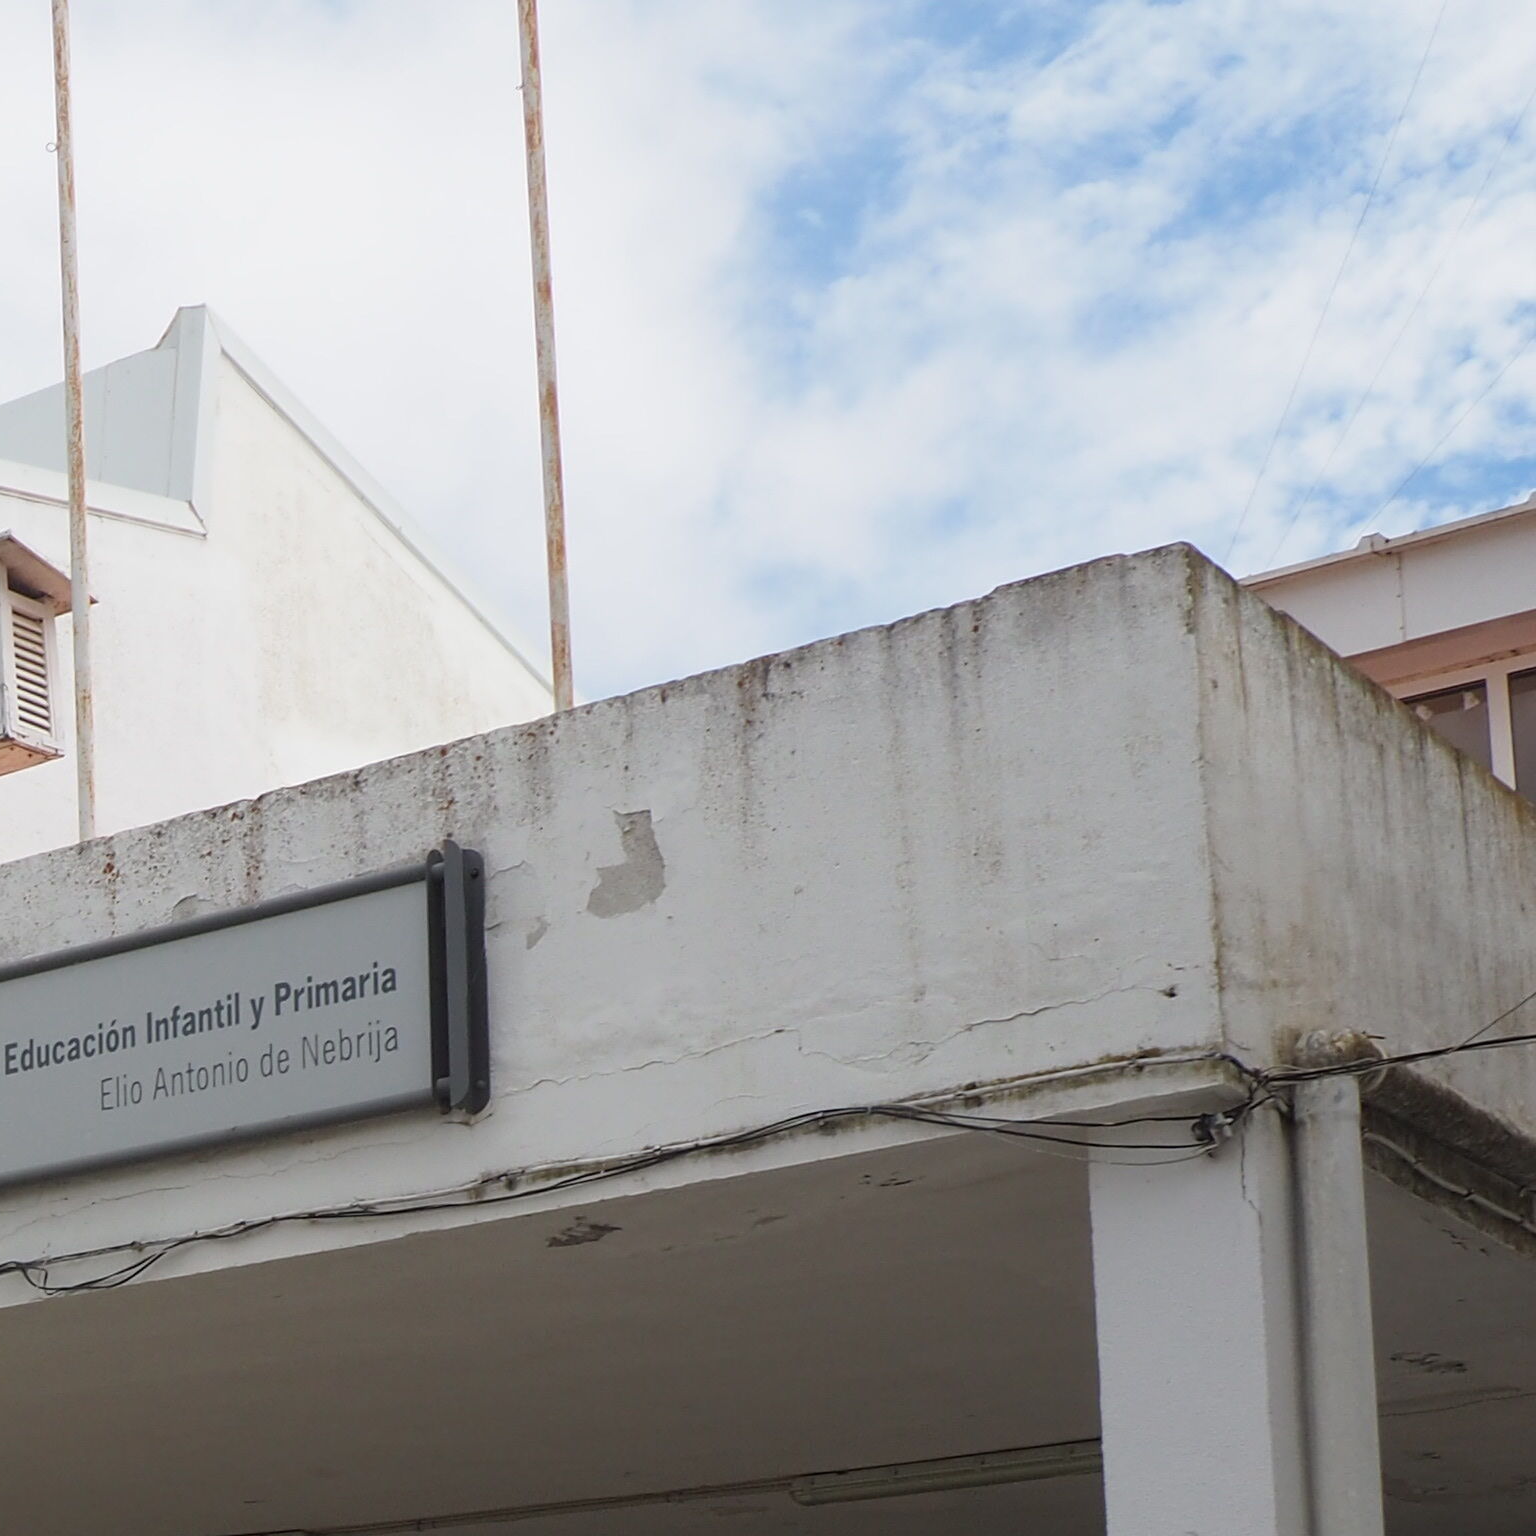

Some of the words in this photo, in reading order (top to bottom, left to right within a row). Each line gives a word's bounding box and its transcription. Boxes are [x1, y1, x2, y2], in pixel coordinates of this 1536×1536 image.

[4, 1019, 136, 1075] Educación
[146, 992, 240, 1044] Infantil
[250, 995, 265, 1030] y
[274, 961, 397, 1016] Primaria
[100, 1073, 143, 1111] Elio
[153, 1052, 249, 1100] Antonio
[260, 1043, 290, 1078] de
[302, 1020, 399, 1069] Nebrija
